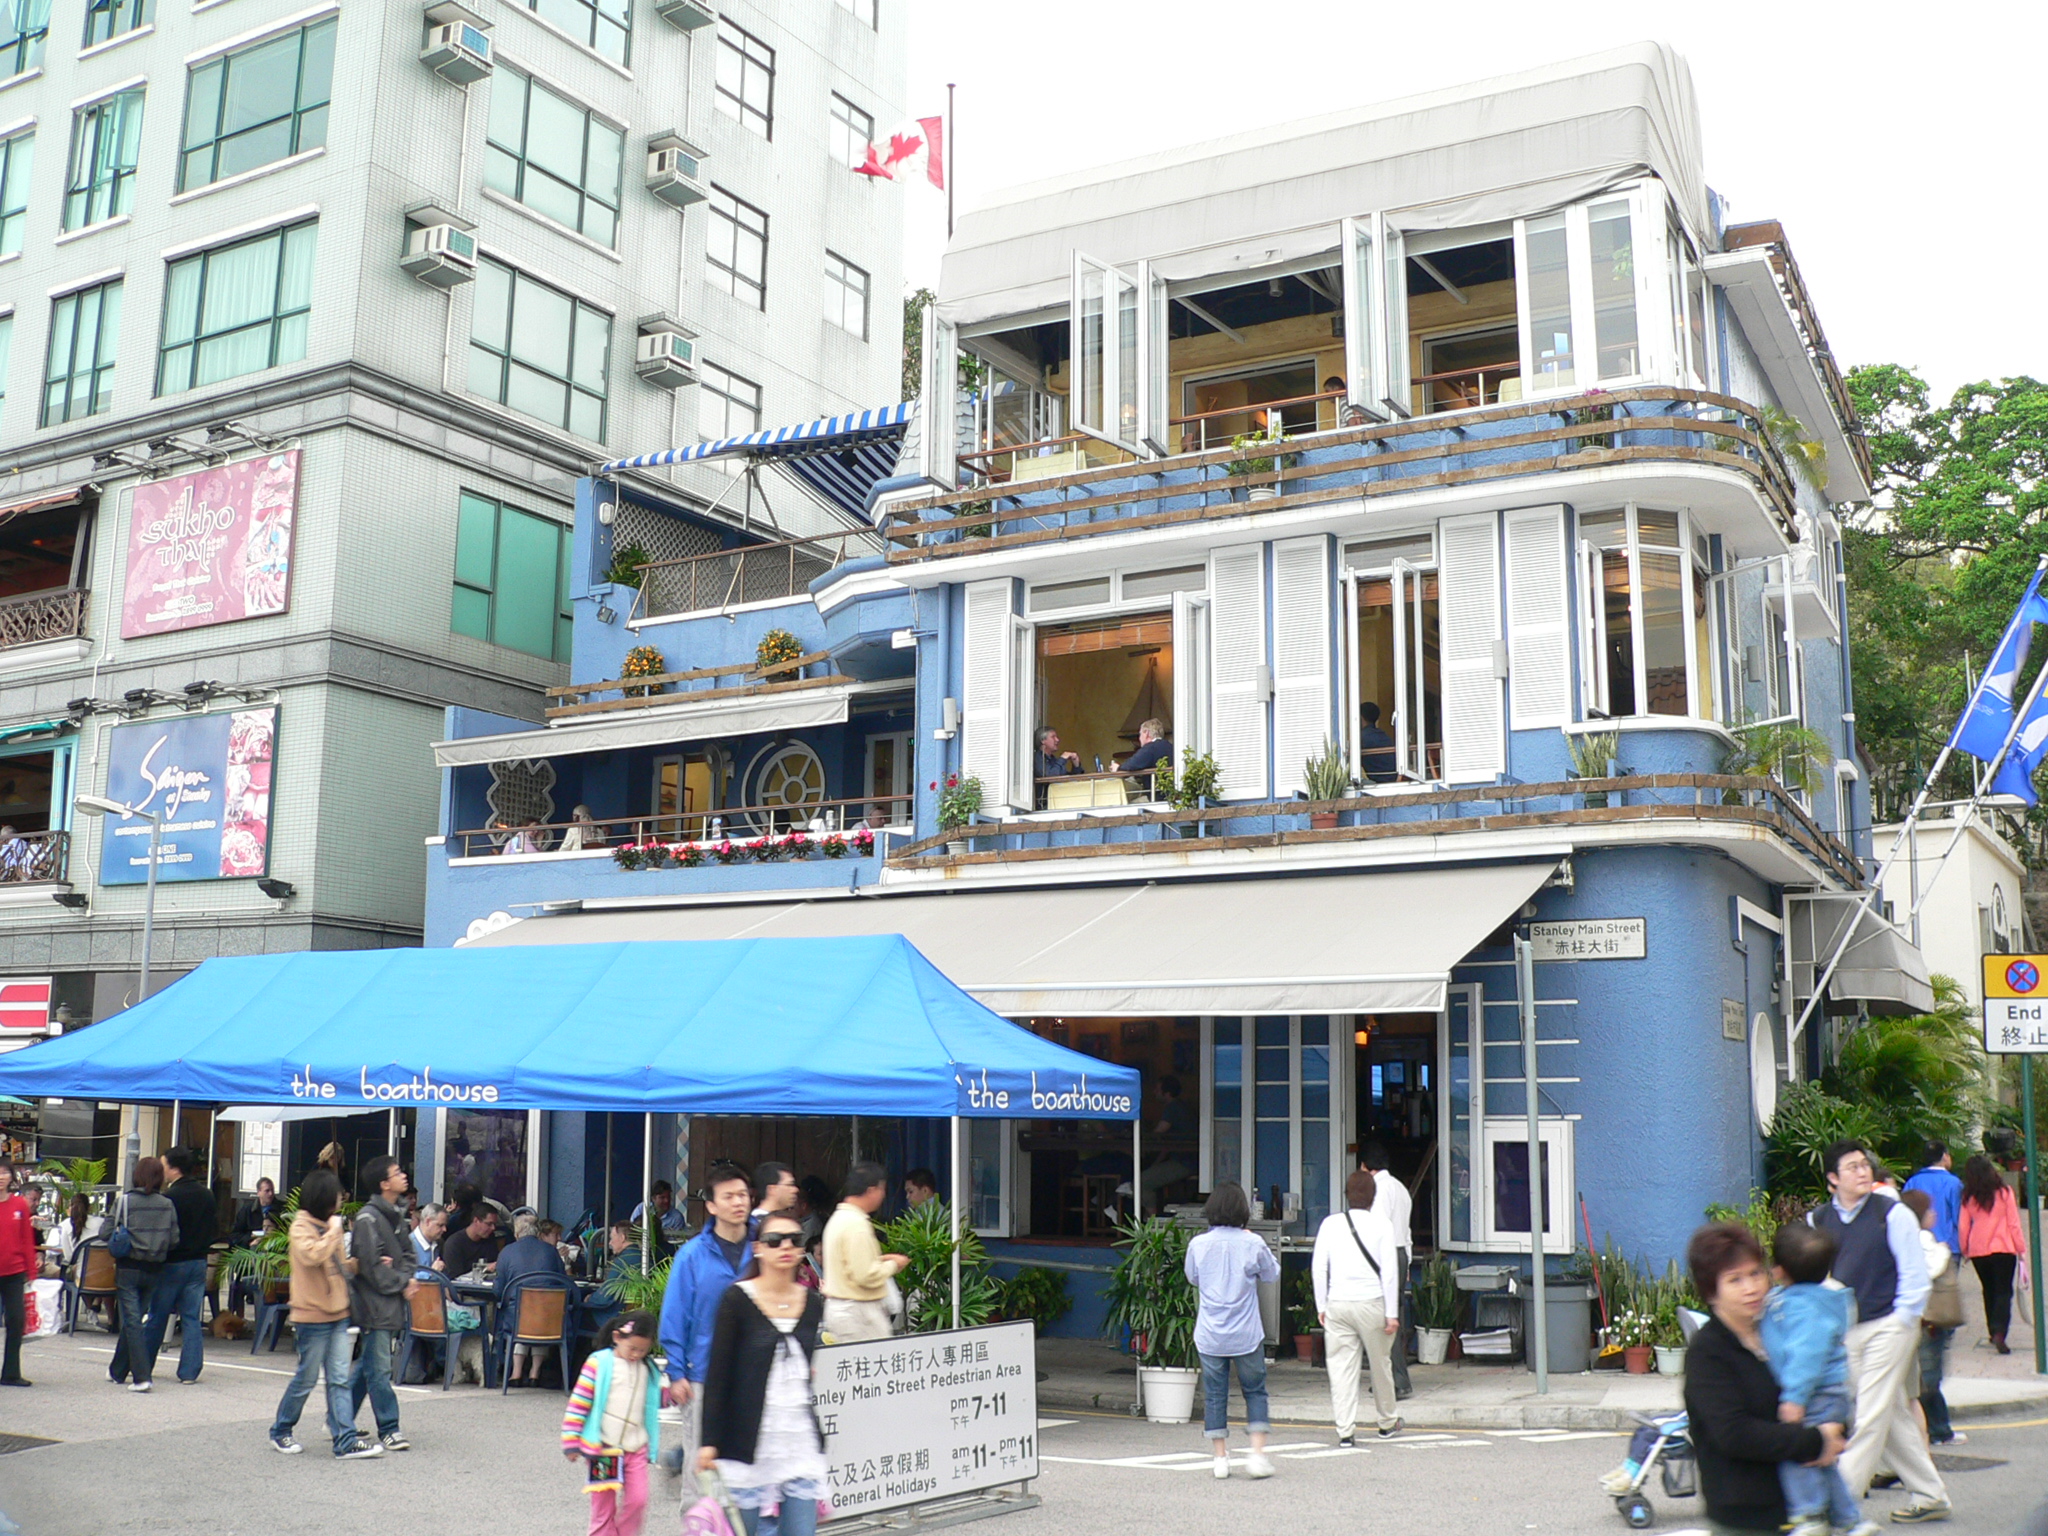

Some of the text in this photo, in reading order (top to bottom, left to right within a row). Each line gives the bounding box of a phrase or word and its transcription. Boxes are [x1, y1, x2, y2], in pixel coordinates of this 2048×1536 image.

[1533, 923, 1641, 937] Stanley Main Street
[1555, 939, 1619, 955] 赤柱大街
[2007, 1005, 2041, 1019] End
[2001, 1026, 2048, 1046] 終止
[291, 1064, 499, 1102] the boathouse
[968, 1067, 1131, 1113] the boathouse
[836, 1341, 989, 1382] 赤柱大街行人專用區
[811, 1363, 1022, 1406] anley Main Street Pedestrian Area
[951, 1397, 968, 1413] pm
[817, 1413, 839, 1436] 五
[950, 1415, 969, 1430] 下午
[952, 1446, 969, 1459] am
[1000, 1437, 1016, 1452] pm
[1019, 1434, 1033, 1459] 11
[952, 1455, 1017, 1479] 上午 下午
[832, 1476, 937, 1508] General Holidays
